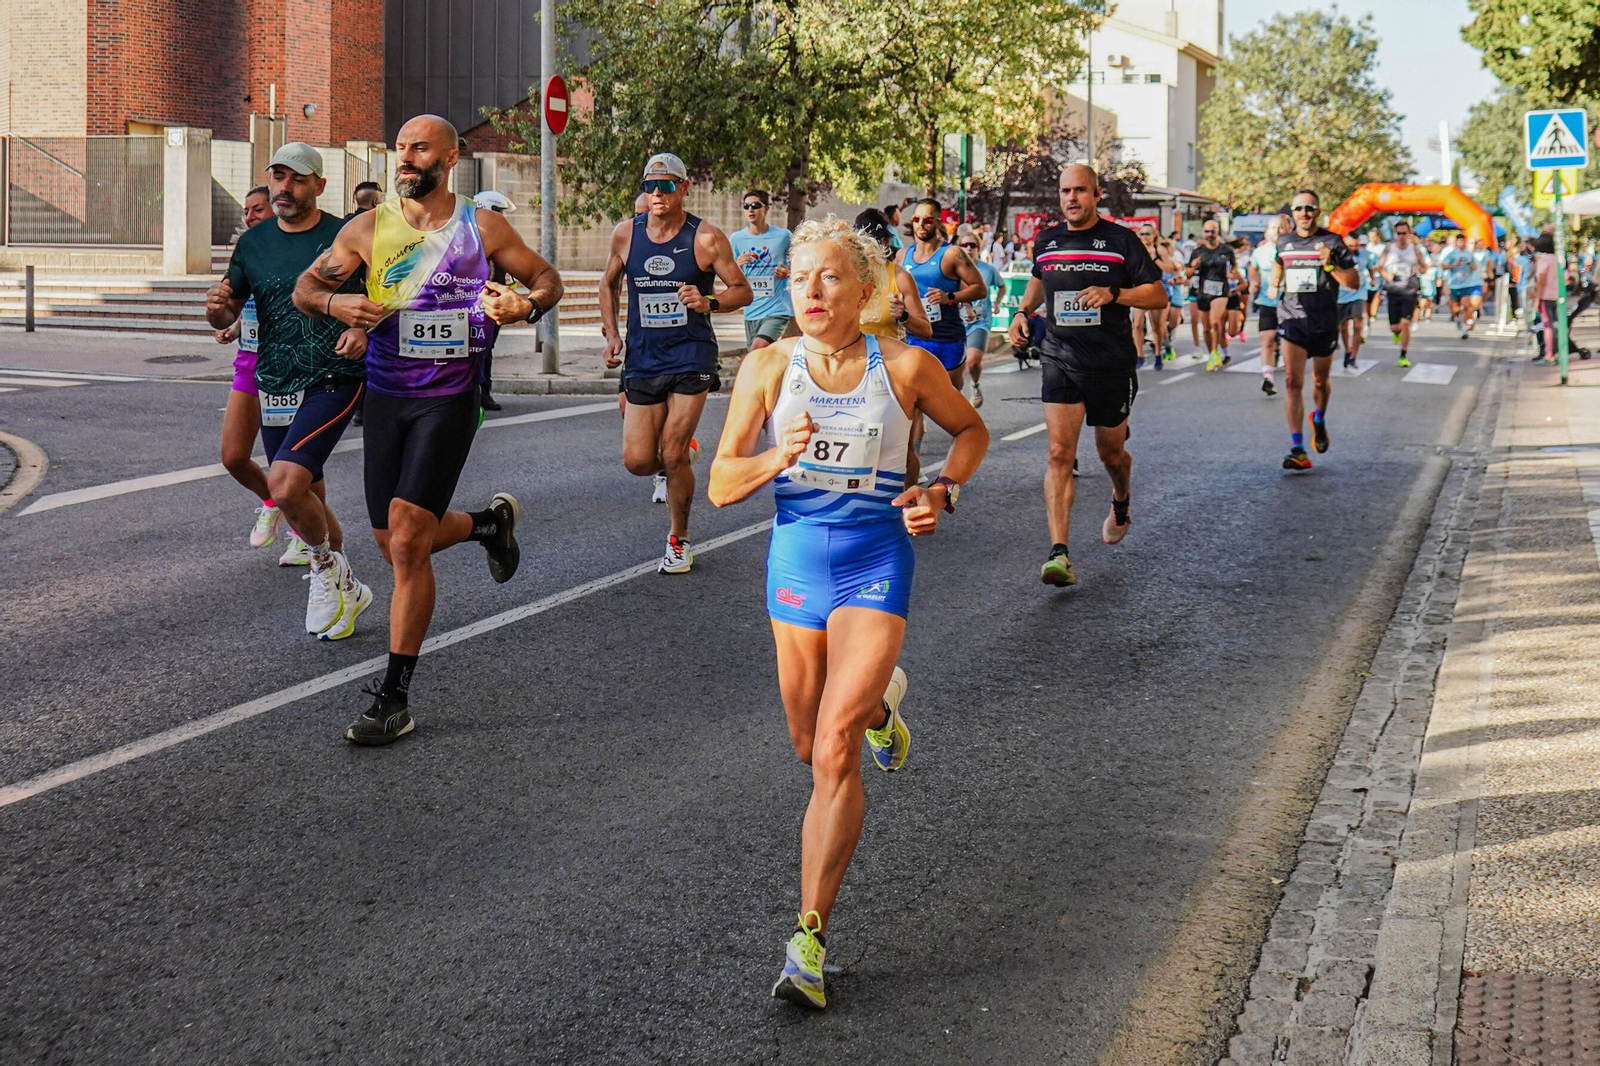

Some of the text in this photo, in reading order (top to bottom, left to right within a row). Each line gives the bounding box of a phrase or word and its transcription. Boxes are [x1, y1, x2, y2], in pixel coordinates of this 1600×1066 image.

[1042, 262, 1110, 273] runrundata
[753, 281, 768, 289] 193
[645, 302, 680, 314] 1137
[413, 323, 452, 339] 815
[264, 393, 298, 407] 1568
[809, 396, 866, 405] MARACENA
[813, 440, 850, 463] 87
